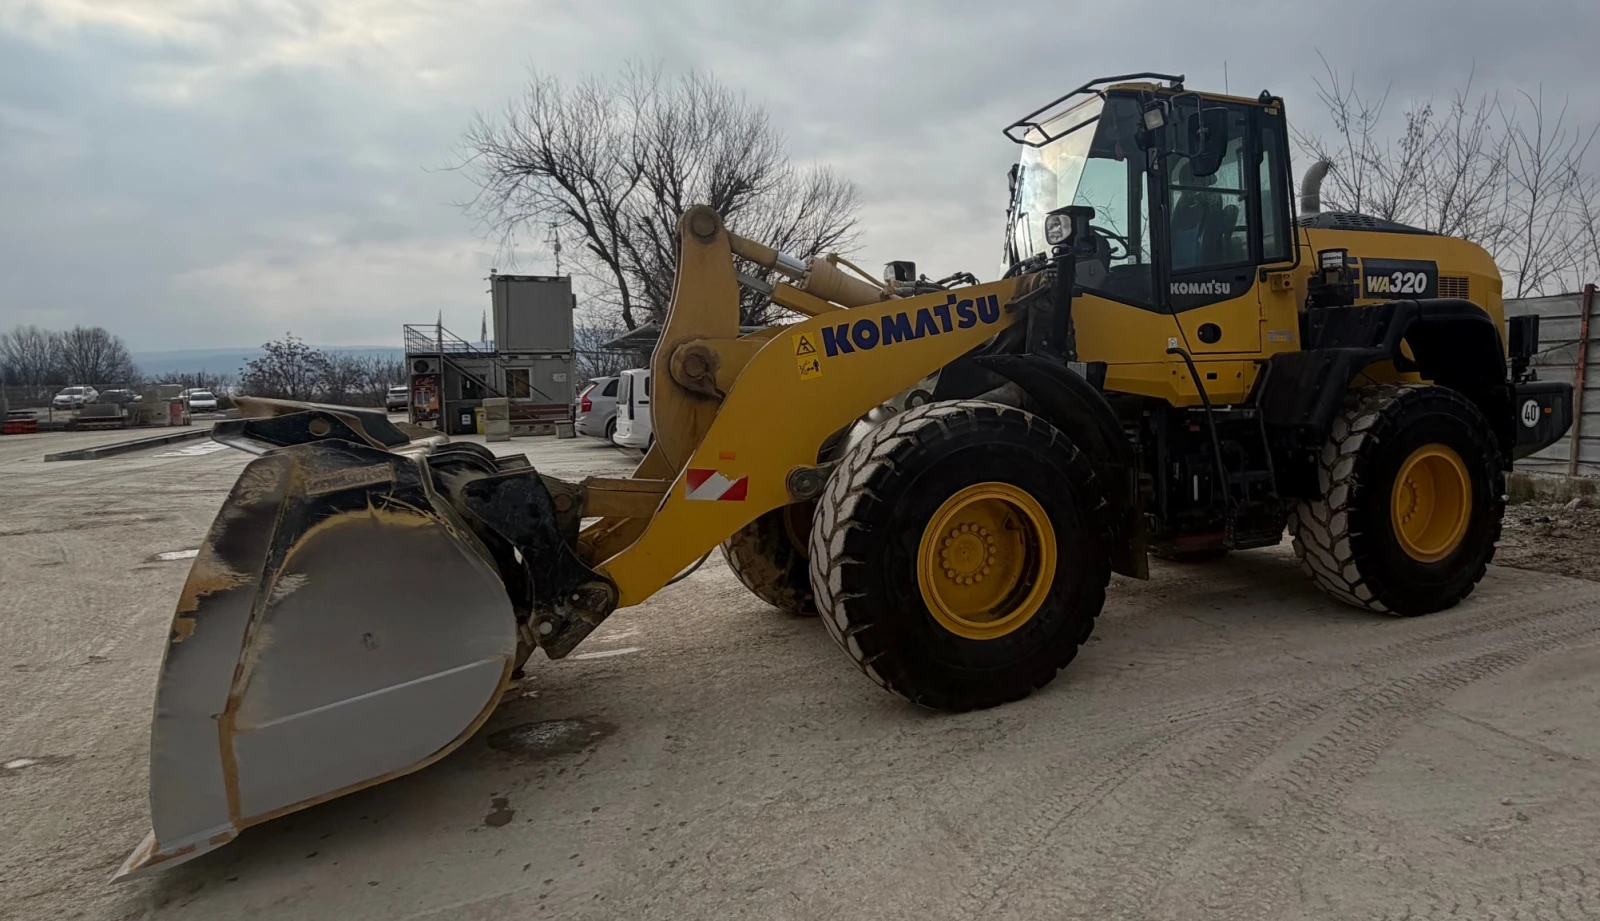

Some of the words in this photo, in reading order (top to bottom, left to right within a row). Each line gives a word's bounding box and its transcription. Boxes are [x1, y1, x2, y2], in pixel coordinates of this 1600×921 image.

[1170, 279, 1231, 295] KOMATSU
[1366, 271, 1428, 294] WA320
[821, 293, 1001, 358] KOMATSU
[1524, 404, 1537, 423] 40
